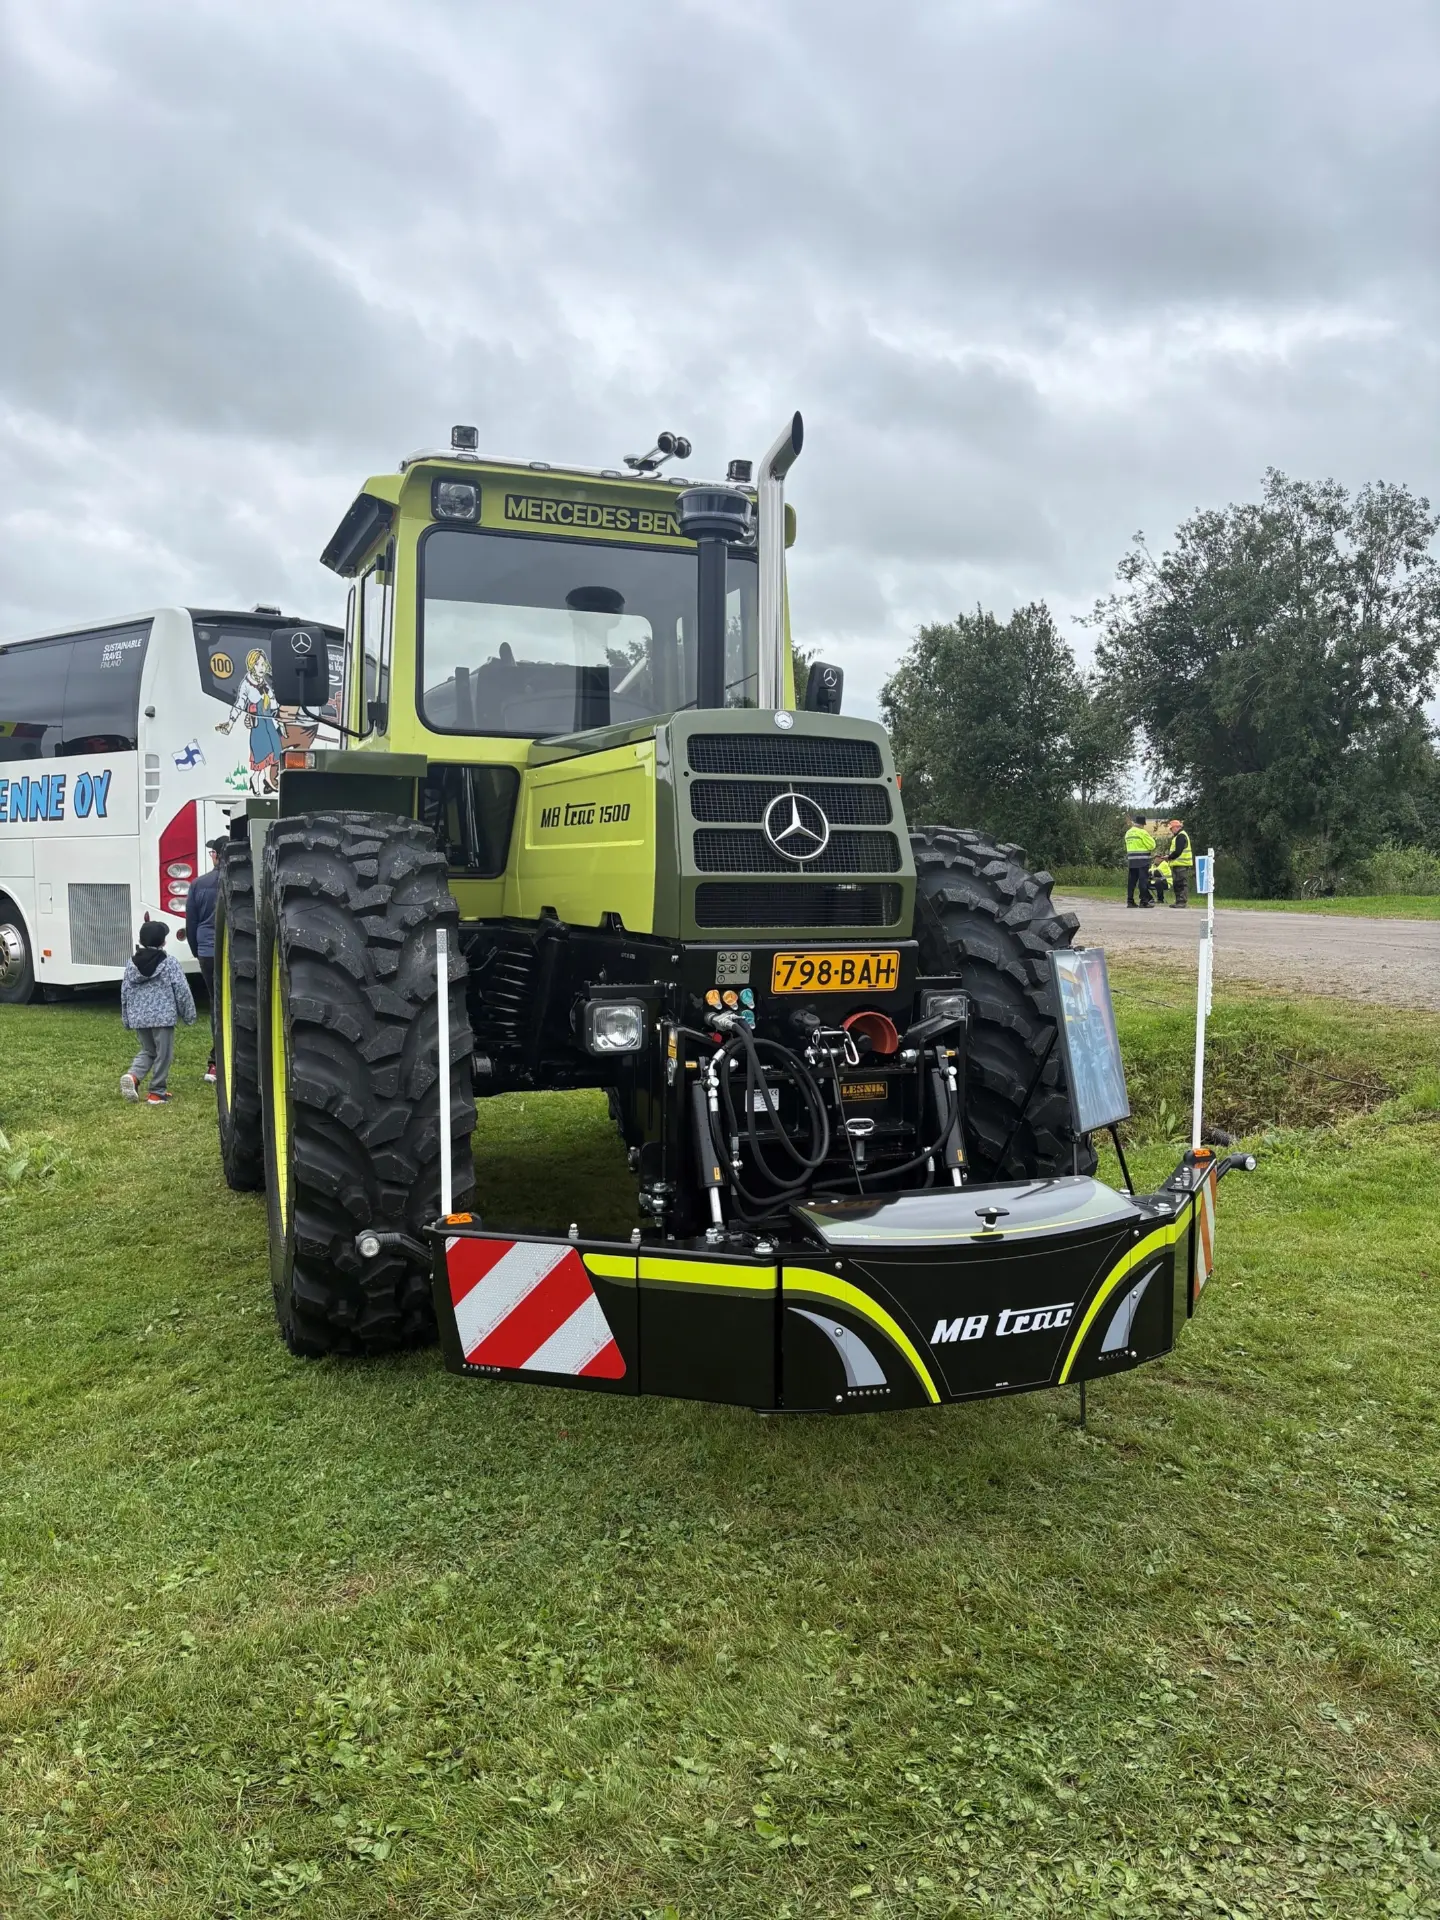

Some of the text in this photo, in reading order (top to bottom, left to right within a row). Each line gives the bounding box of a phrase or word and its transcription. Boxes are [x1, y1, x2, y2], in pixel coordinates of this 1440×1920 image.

[507, 497, 682, 535] MERCEDES-BEN
[104, 639, 142, 652] SUSTAINABLE
[100, 659, 121, 668] FINLAND
[102, 651, 122, 661] TRAVEL
[212, 658, 231, 673] 100
[74, 769, 112, 818] OY
[541, 803, 630, 828] MB trac 1500
[782, 958, 892, 987] 798-BAH
[842, 1084, 884, 1094] LESNIK
[930, 1302, 1075, 1344] MB trac
